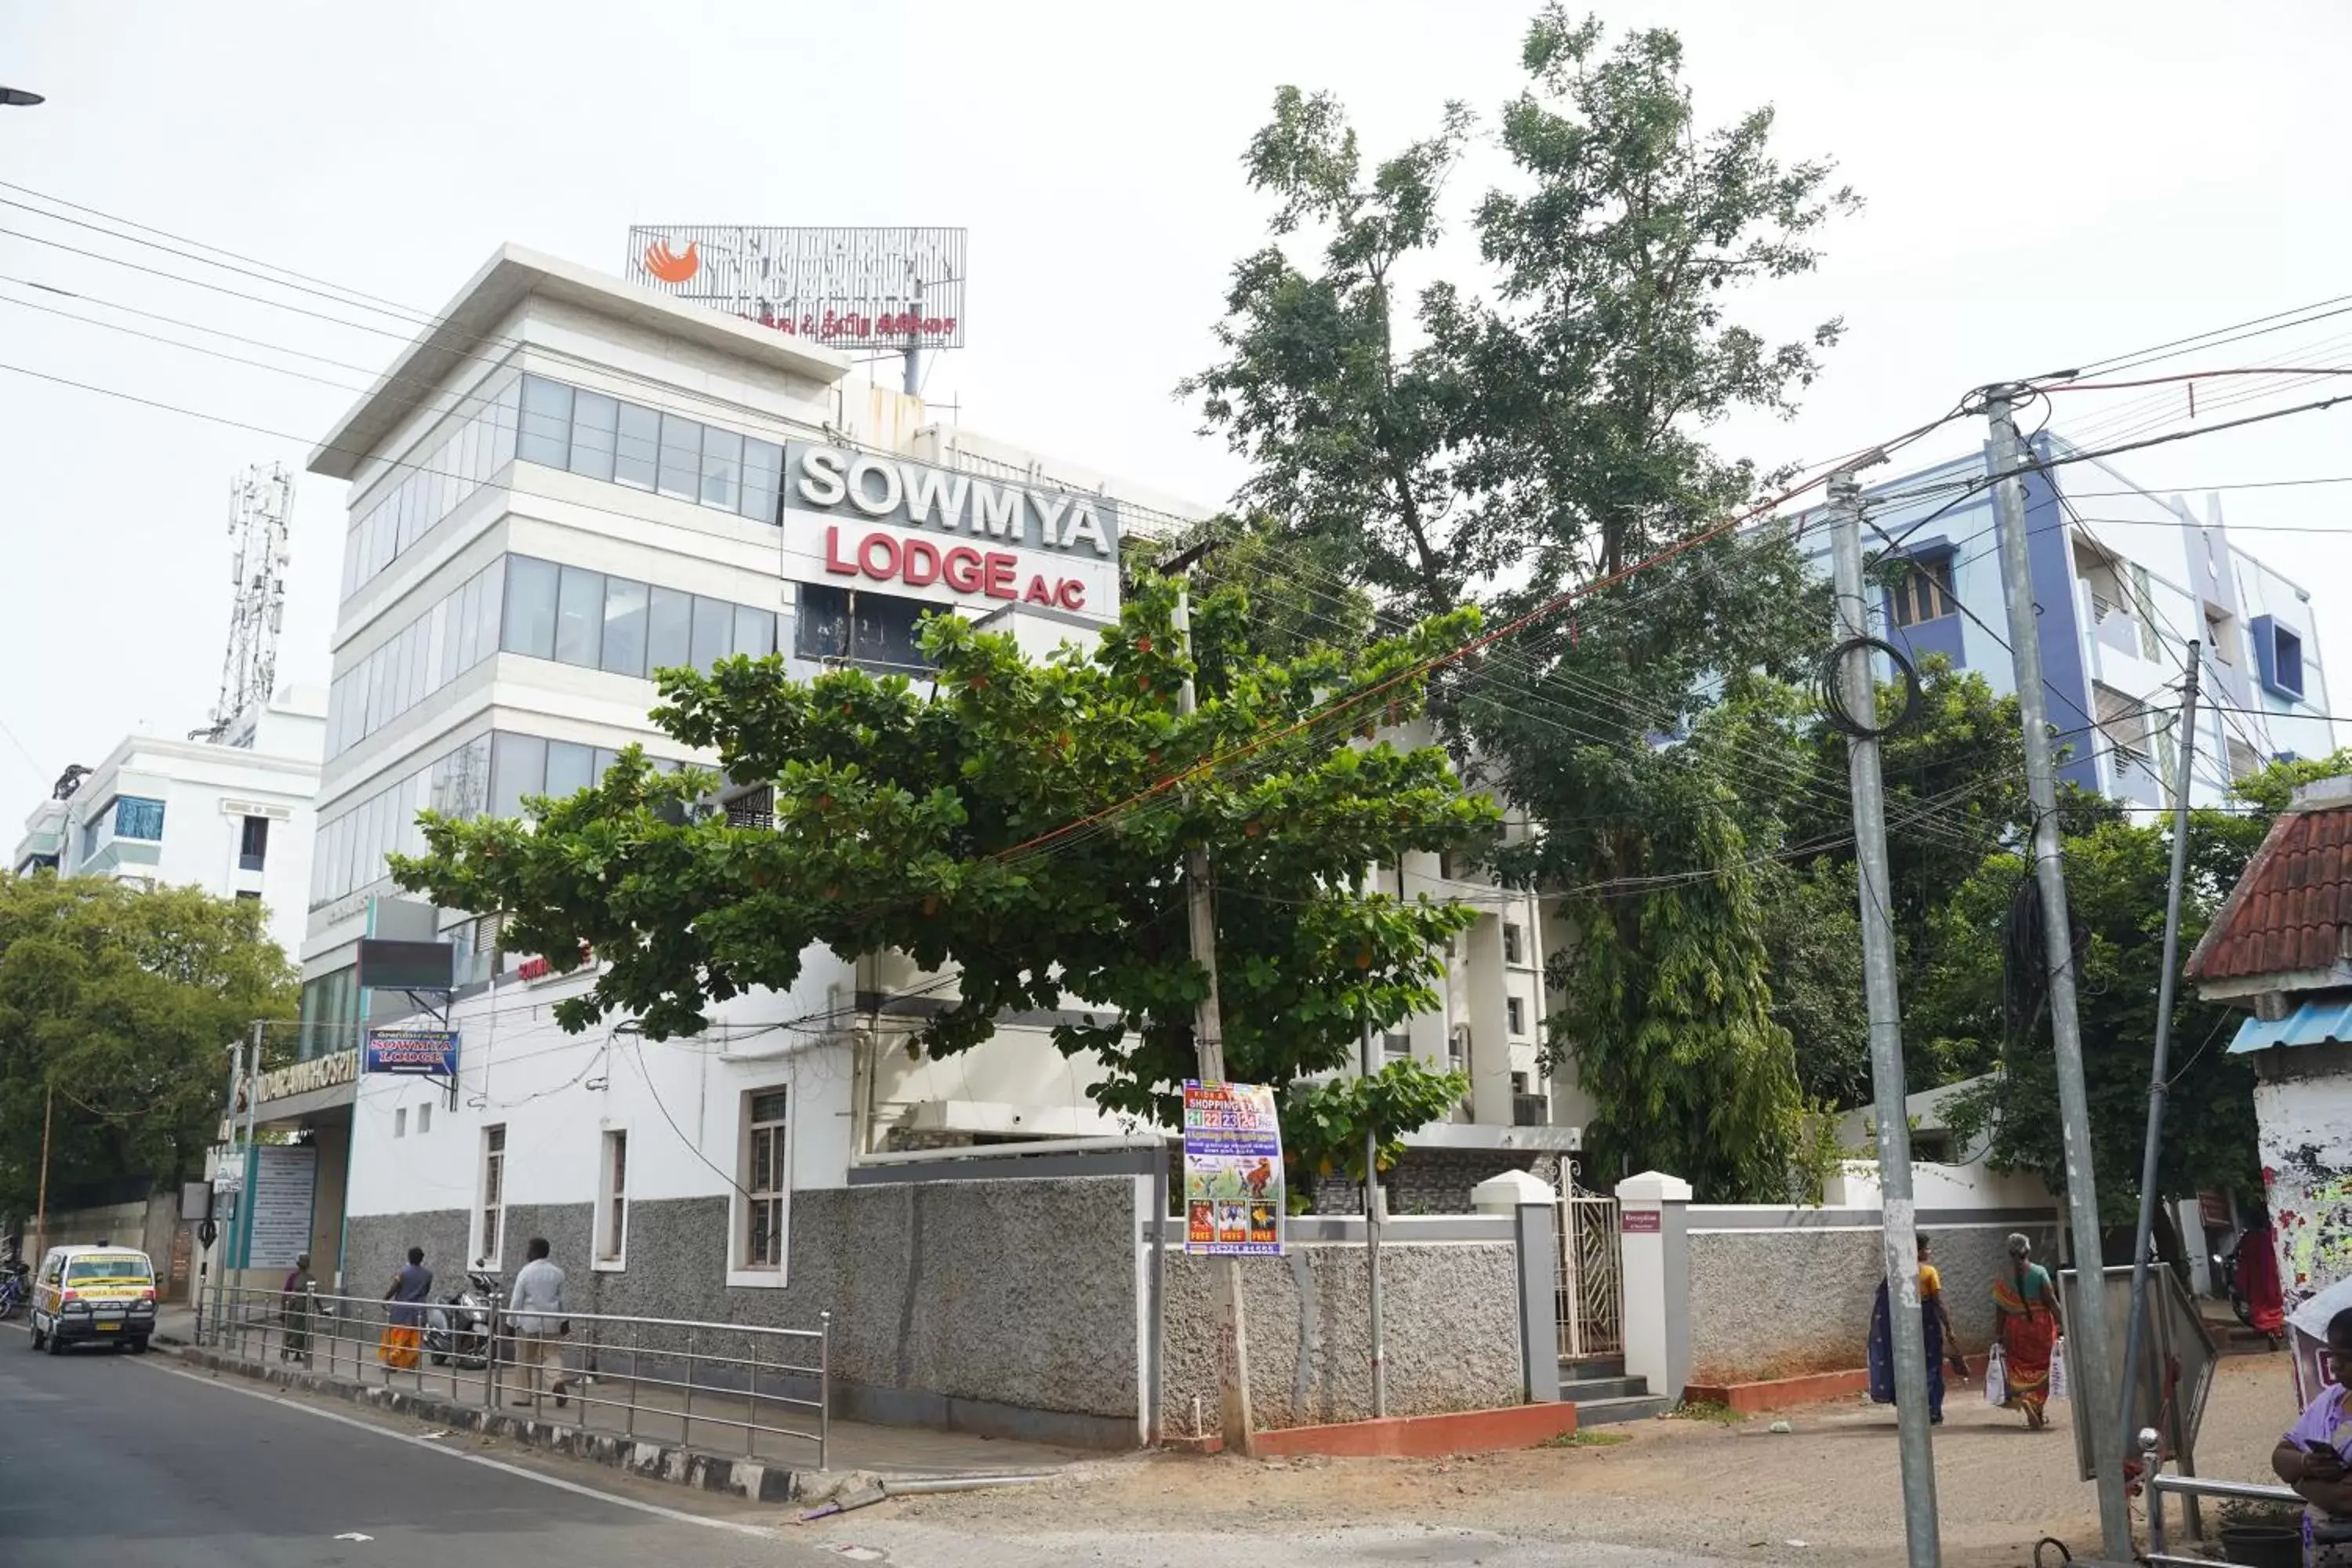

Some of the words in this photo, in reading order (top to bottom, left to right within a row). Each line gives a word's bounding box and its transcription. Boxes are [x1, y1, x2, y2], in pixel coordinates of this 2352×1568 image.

[717, 229, 941, 262] SUNDARAM
[731, 272, 928, 304] HOSPITAL
[798, 447, 1112, 555] SOWMYA
[826, 525, 1019, 601] LODGE
[1024, 574, 1086, 610] A/C
[369, 1040, 452, 1051] SOWMYA
[379, 1051, 441, 1063] LODGE
[1189, 1099, 1238, 1111] SHOPPING
[1204, 1112, 1218, 1127] 22
[1222, 1113, 1237, 1127] 23
[1241, 1114, 1256, 1129] 24
